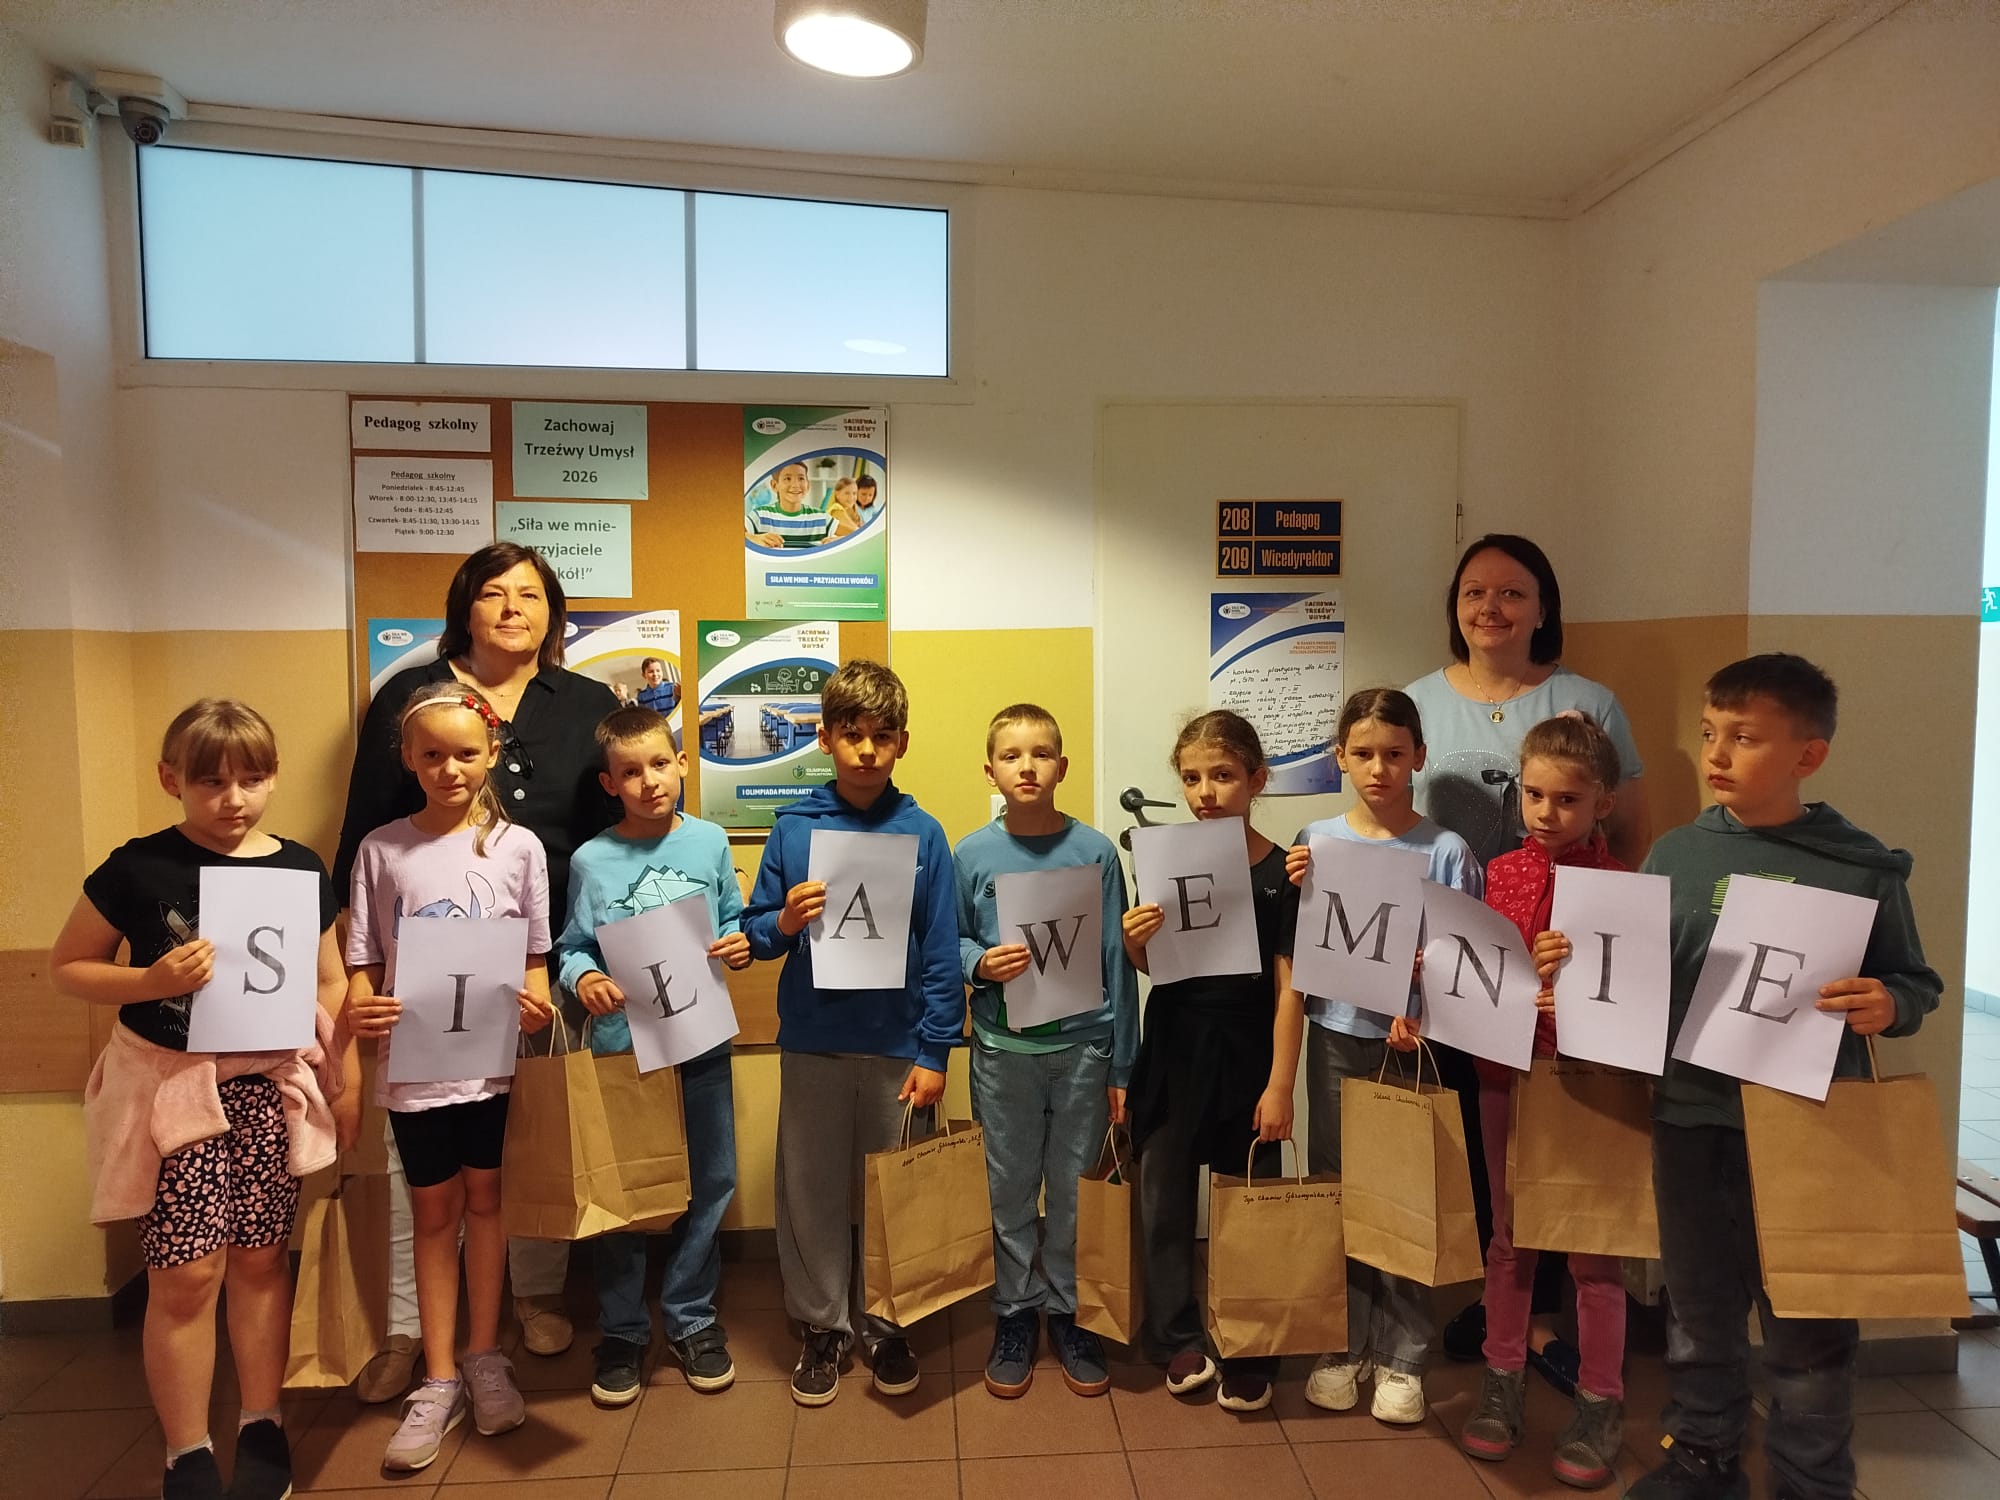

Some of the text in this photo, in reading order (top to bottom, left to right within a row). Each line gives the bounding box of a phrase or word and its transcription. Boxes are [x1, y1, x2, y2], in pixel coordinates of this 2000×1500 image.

[364, 415, 478, 432] Pedagog szkolny
[544, 418, 615, 436] Zachowaj
[524, 442, 634, 460] Trzeźwy Umysł
[391, 471, 456, 480] Pedagog szkolny
[562, 470, 598, 484] 2026
[394, 505, 413, 513] Środa
[548, 521, 569, 532] we
[574, 519, 617, 533] mnie-
[1222, 508, 1320, 530] 208 Pedagog
[1222, 547, 1334, 570] 209 Wicedyrektor
[745, 788, 777, 796] OLIMPIADA
[778, 788, 813, 796] PROFILAKTY
[829, 882, 885, 940] A
[1169, 873, 1222, 933] E
[1016, 914, 1088, 976] W
[1315, 889, 1400, 965] M
[243, 926, 285, 995] S
[1444, 932, 1512, 1008] N
[1588, 931, 1621, 1005] I
[643, 960, 698, 1019] Ł
[1729, 941, 1806, 1025] E
[443, 975, 470, 1033] I
